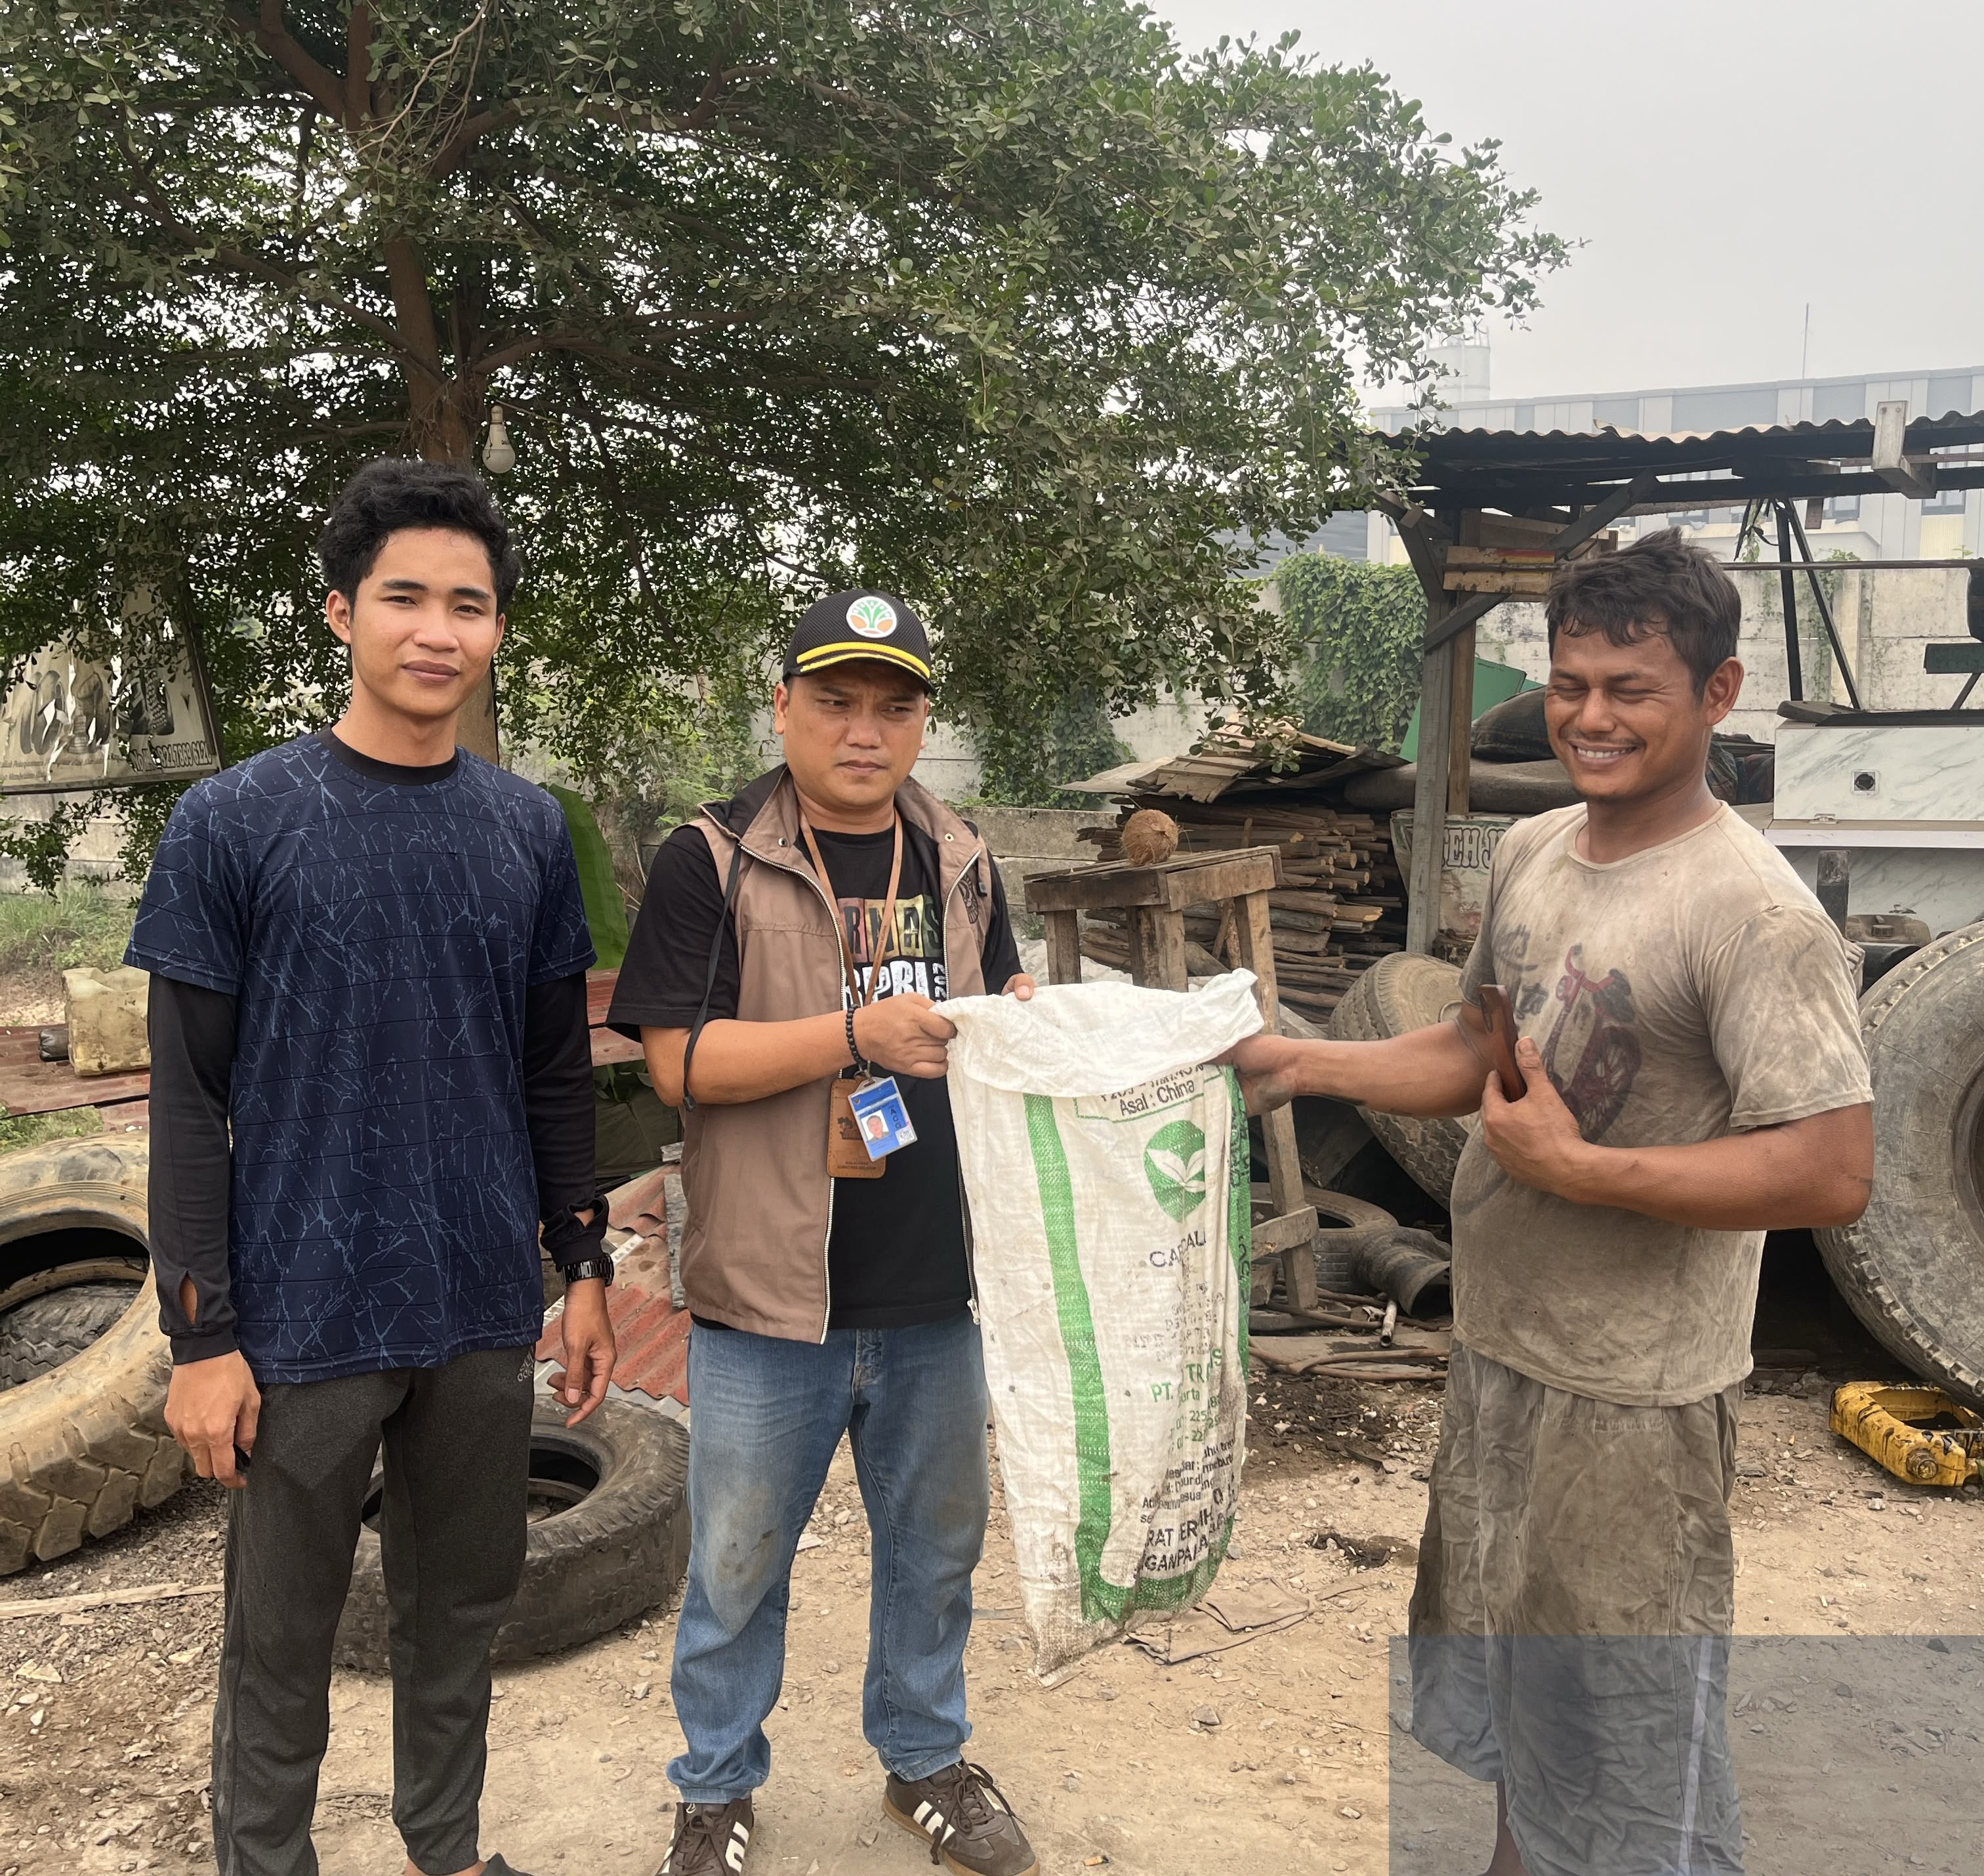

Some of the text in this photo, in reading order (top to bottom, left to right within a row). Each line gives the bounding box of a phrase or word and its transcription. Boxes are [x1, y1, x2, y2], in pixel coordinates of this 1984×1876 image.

[1119, 1093, 1149, 1116] Asal
[1156, 1079, 1195, 1104] China
[1150, 1381, 1174, 1403] PT.
